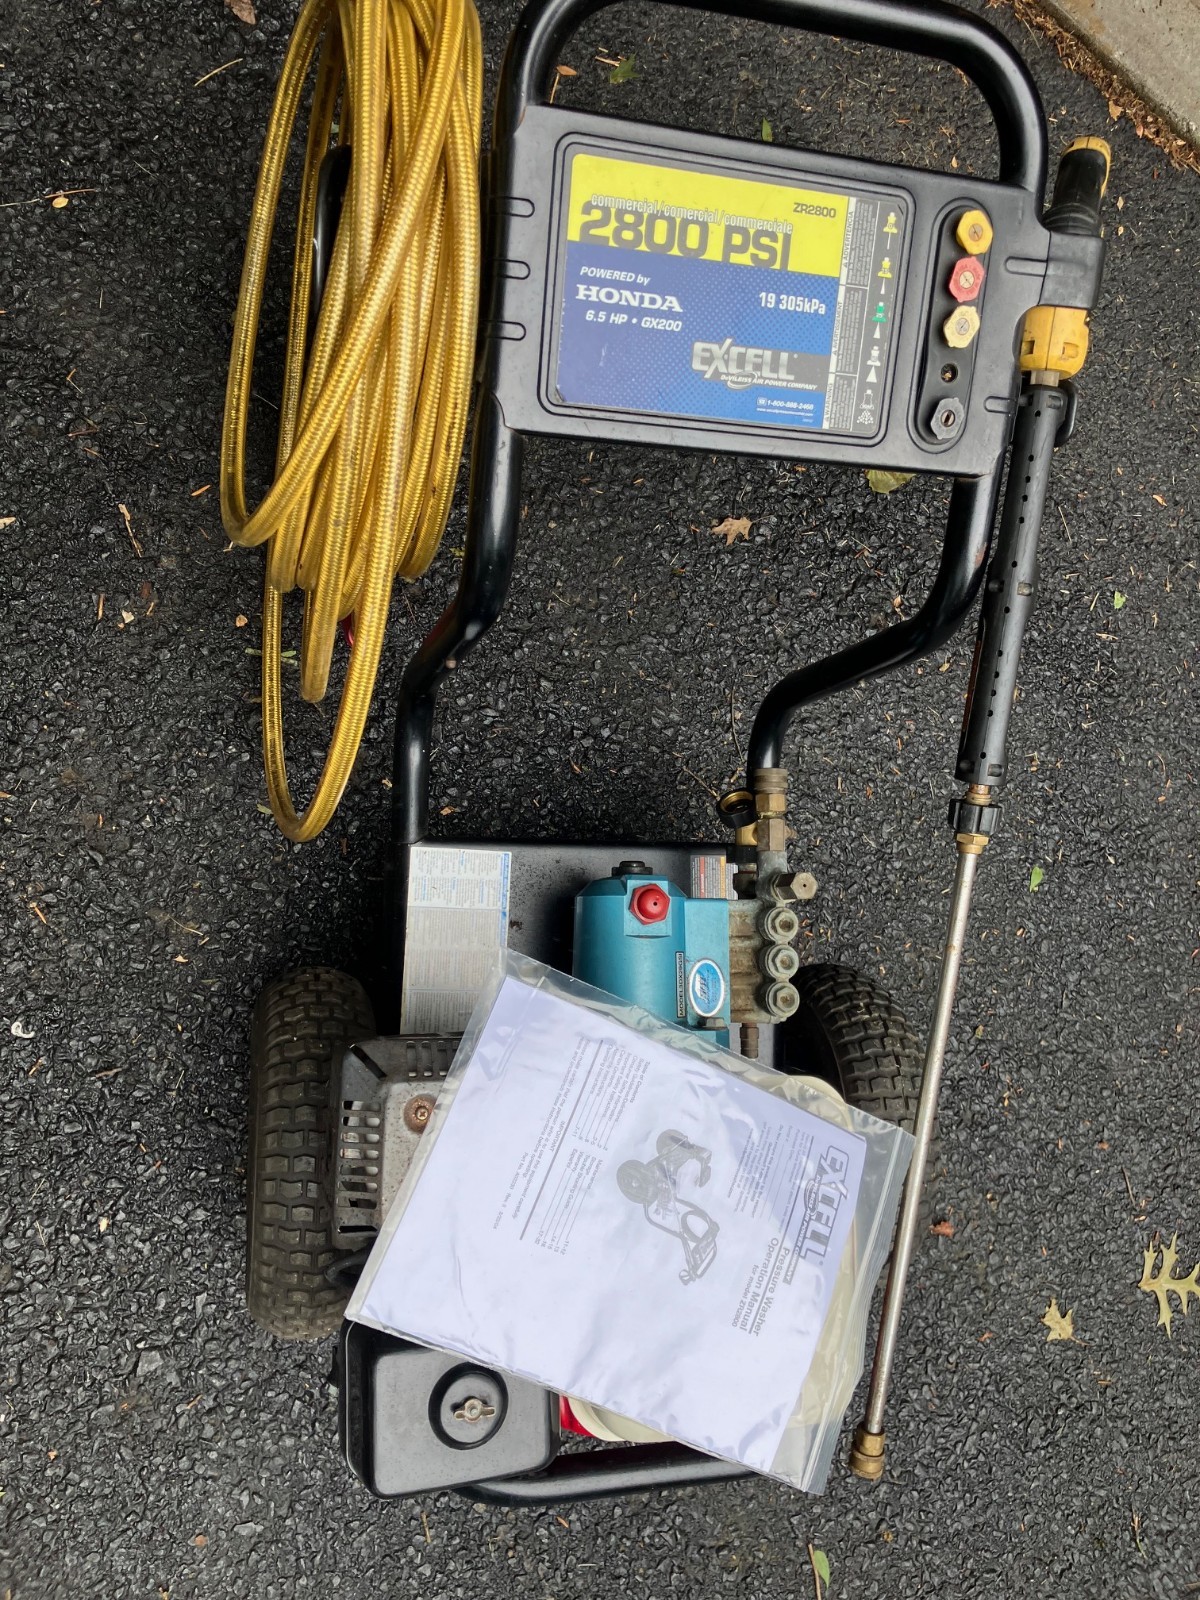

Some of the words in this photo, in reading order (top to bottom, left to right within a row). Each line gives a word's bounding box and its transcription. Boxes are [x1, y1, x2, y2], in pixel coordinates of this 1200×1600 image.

[793, 201, 837, 219] ZR2800
[578, 200, 710, 259] 2800
[722, 223, 793, 271] PSI
[842, 210, 853, 260] ADVERTENCIA
[580, 266, 635, 284] POWERED
[637, 275, 651, 286] by
[576, 284, 683, 312] HONDA
[758, 292, 775, 308] 19
[778, 296, 826, 315] 305kPa
[586, 310, 606, 323] 6.5
[610, 312, 628, 324] HP
[641, 316, 682, 332] GX200
[692, 338, 794, 380] EXCELL
[764, 379, 786, 387] POWER
[788, 382, 818, 390] COMPANY
[796, 1220, 807, 1247] POWER
[750, 1264, 759, 1275] for
[754, 1236, 779, 1289] Operation
[767, 1246, 790, 1294] Pressure
[741, 1275, 755, 1299] model
[738, 1291, 760, 1331] Manual
[752, 1295, 773, 1337] Washer
